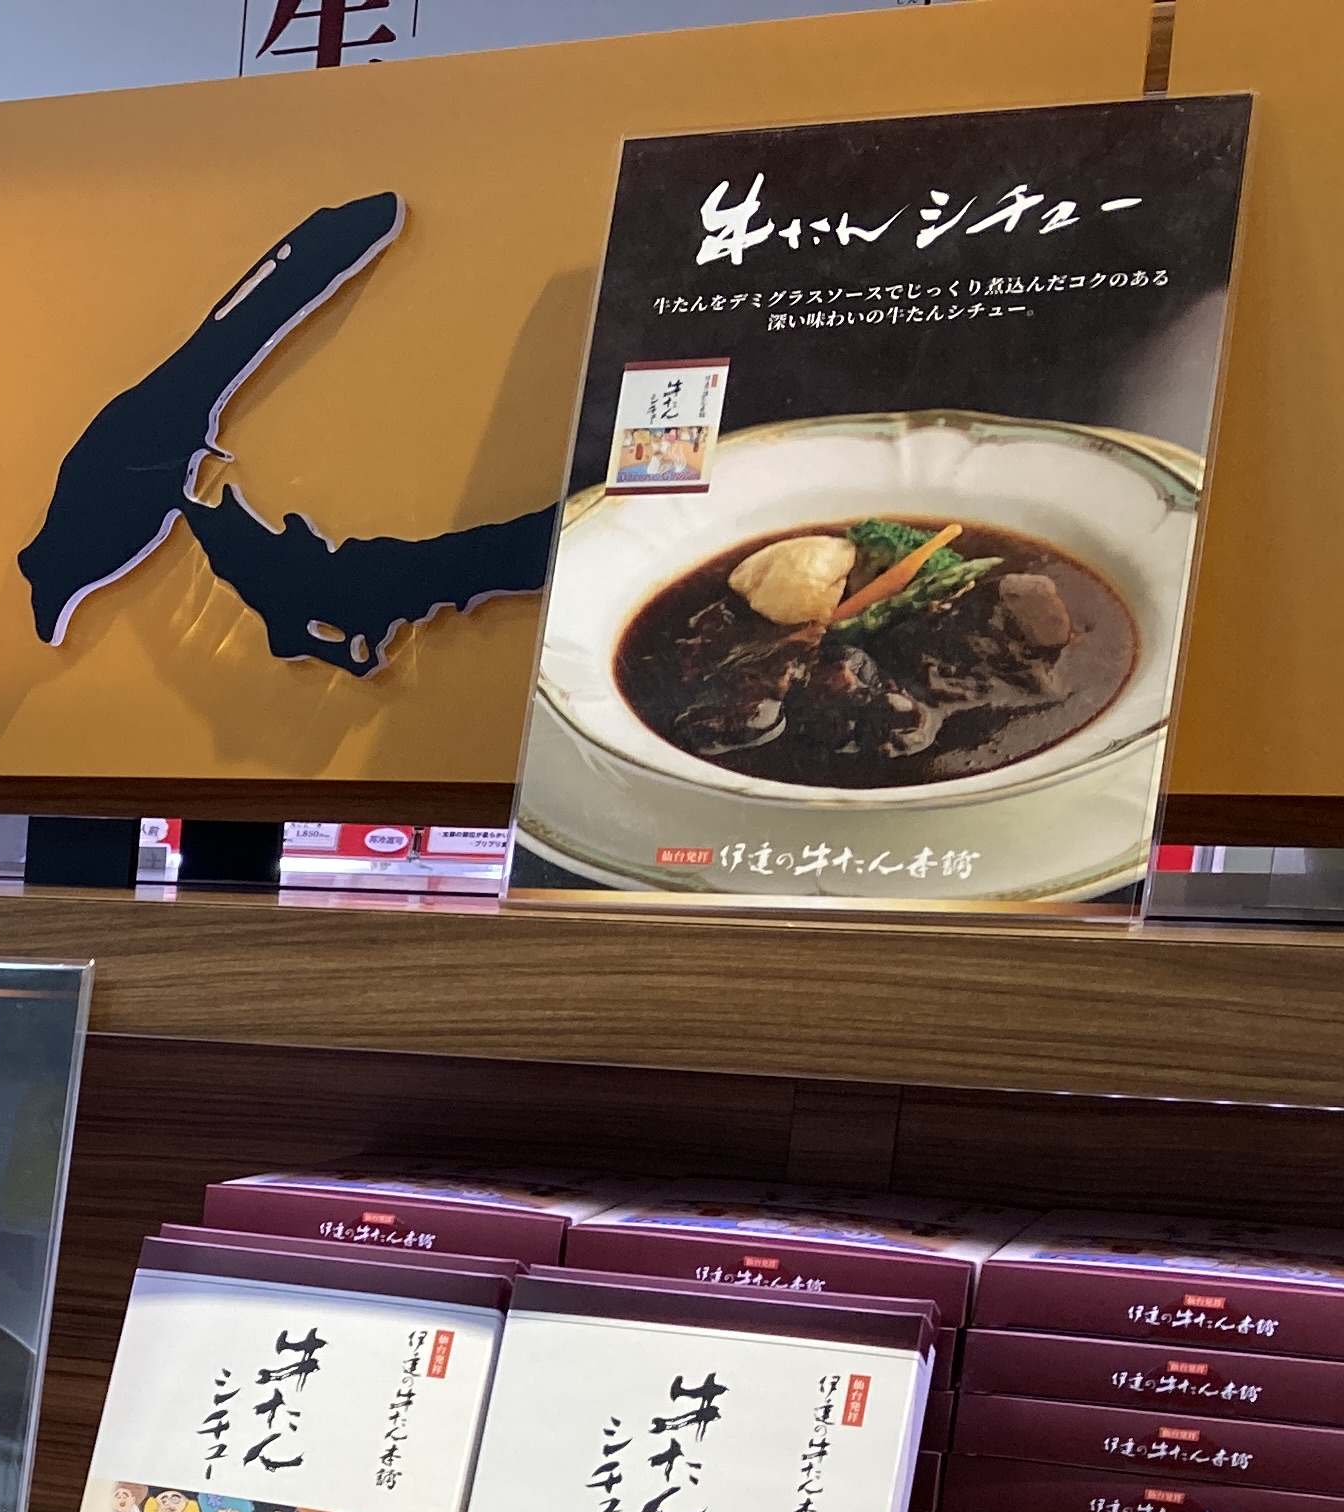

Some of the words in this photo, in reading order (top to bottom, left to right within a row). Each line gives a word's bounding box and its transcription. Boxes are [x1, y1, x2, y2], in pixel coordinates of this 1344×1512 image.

[695, 172, 906, 267] 牛たん
[916, 183, 1144, 251] シチュー
[652, 267, 1171, 318] 牛たんをデミグラスソースでじっくり煮込んだコクのある
[765, 303, 1038, 334] 深い味わいの牛たんシチュー。
[718, 842, 982, 881] 伊達の牛たん本舗
[319, 1220, 437, 1251] 伊達の牛たん本舗
[1126, 1303, 1279, 1338] 伊達の牛たん本舗
[243, 1326, 329, 1473] 牛たん
[1110, 1370, 1262, 1404] 伊達の牛たん本舗
[195, 1368, 242, 1482] シチュー
[375, 1329, 429, 1491] 伊達の牛たん本舗
[1102, 1435, 1253, 1471] 伊達の牛たん本舗
